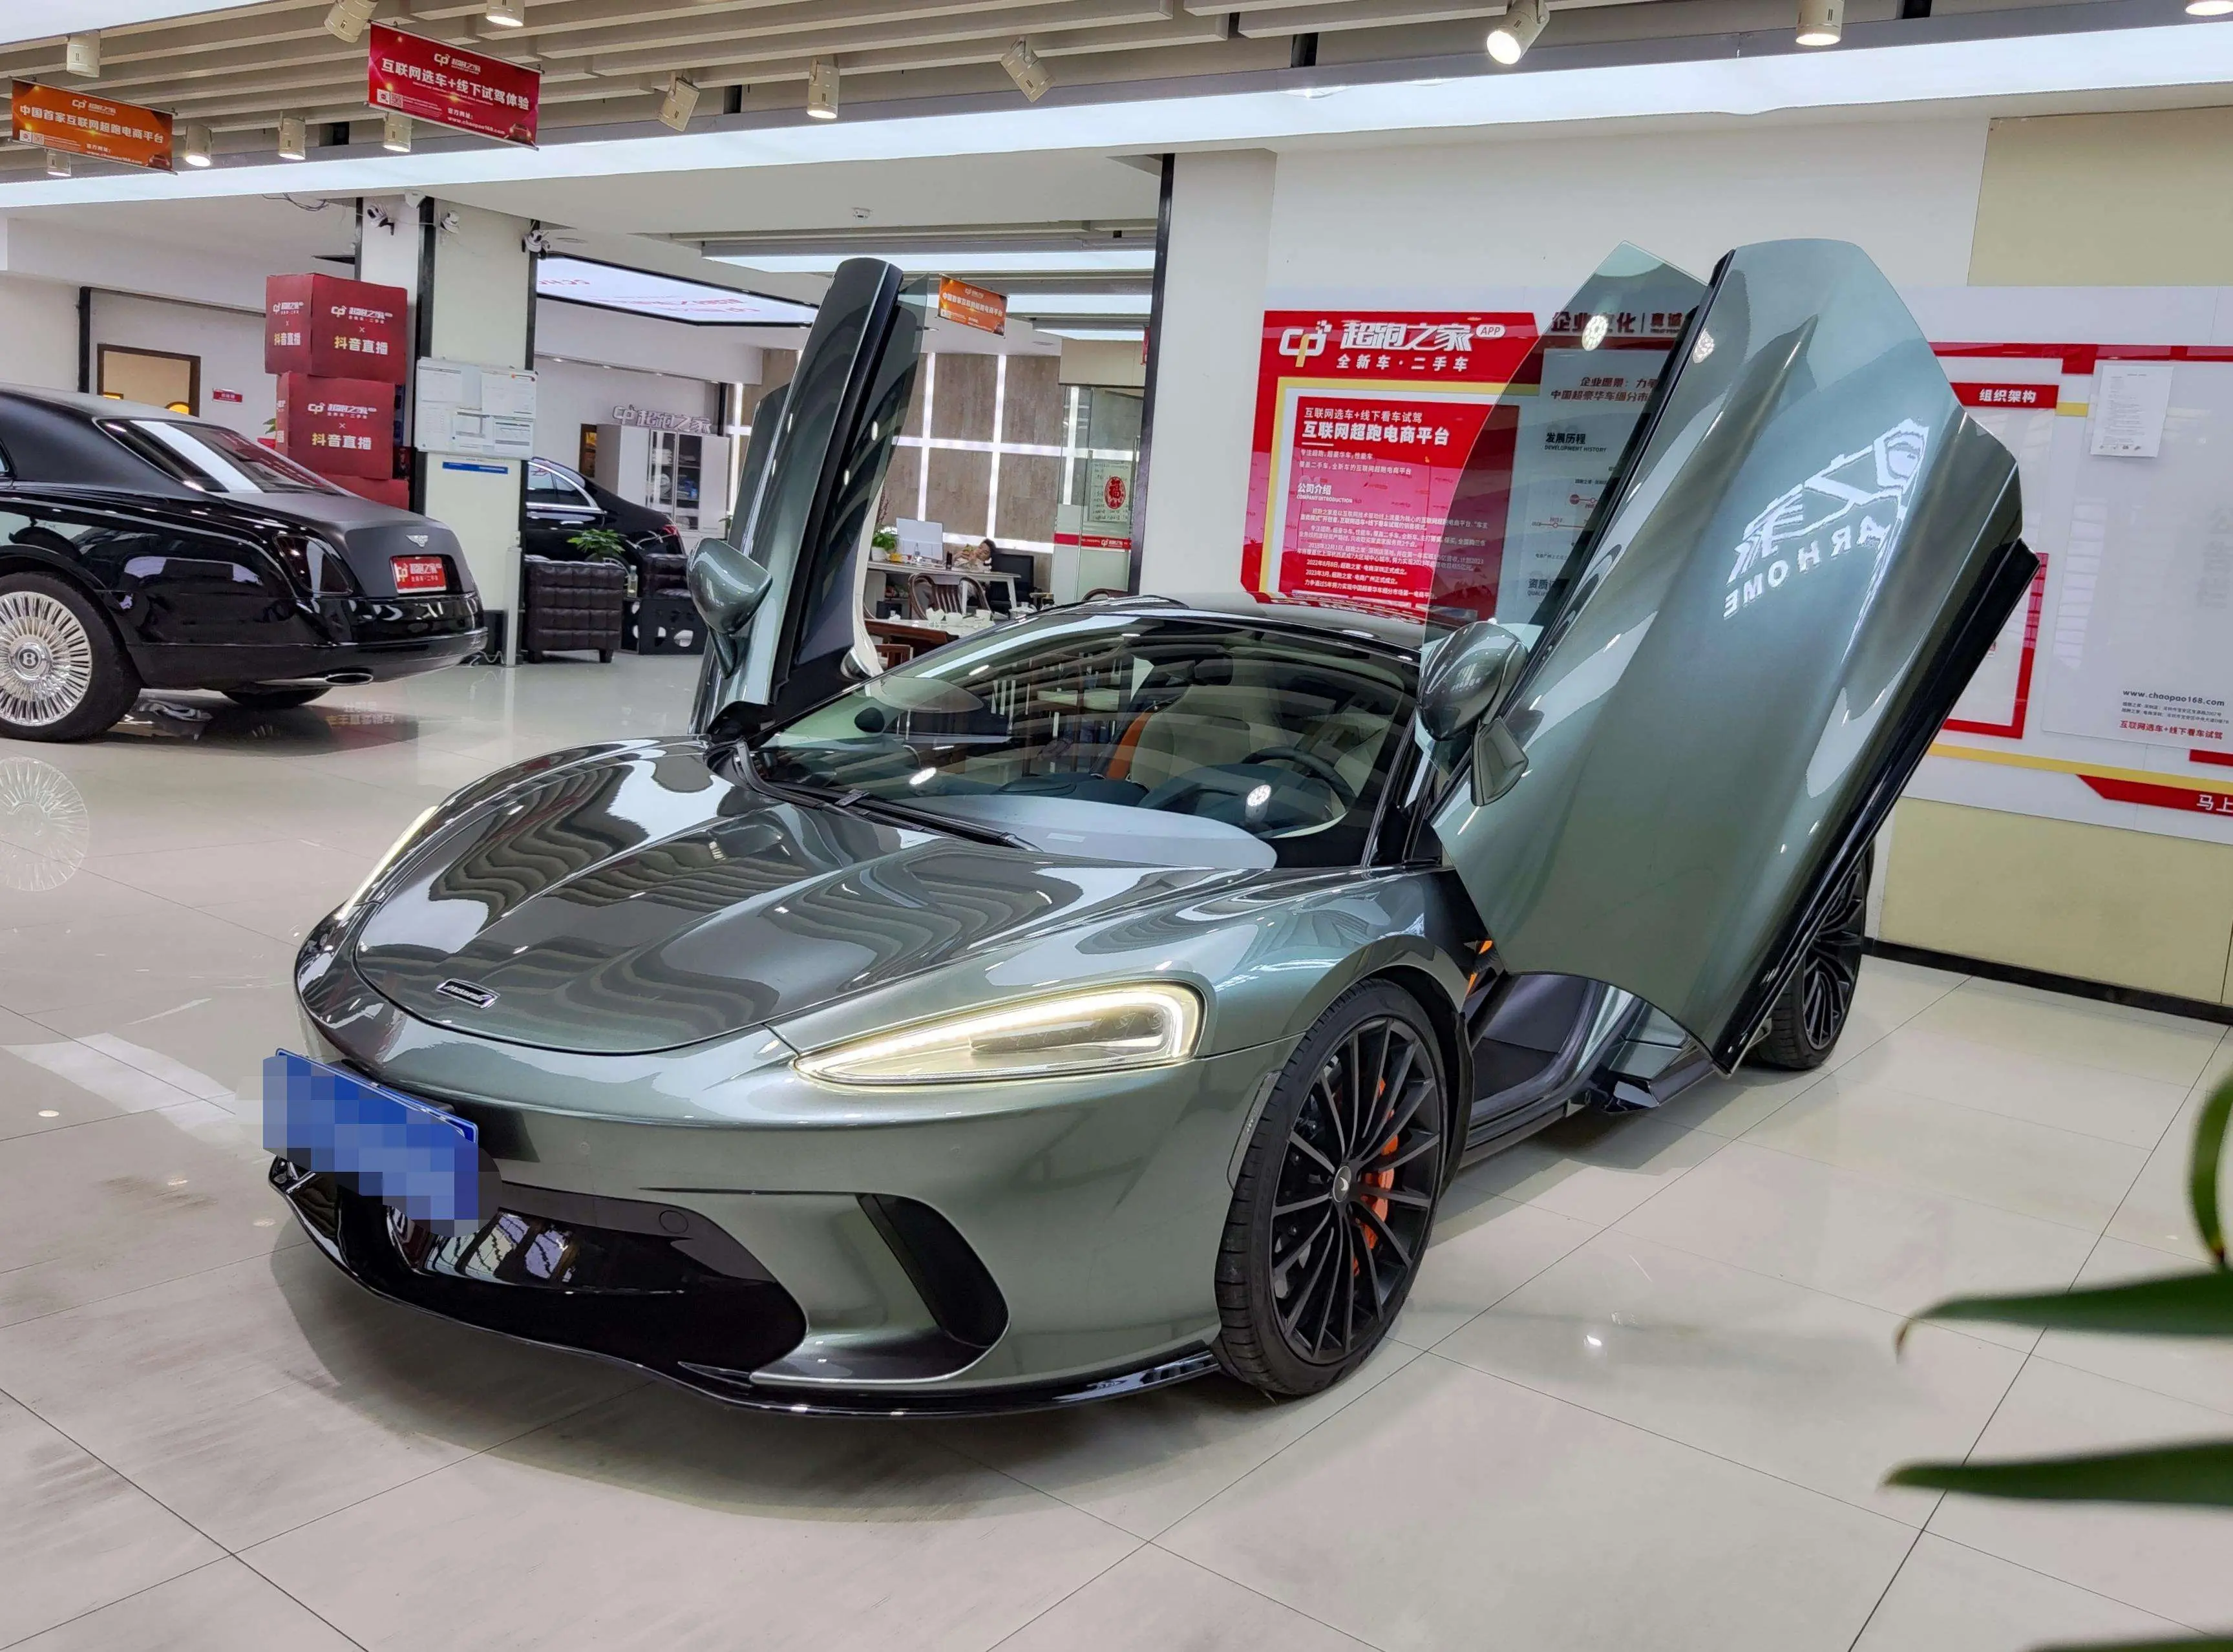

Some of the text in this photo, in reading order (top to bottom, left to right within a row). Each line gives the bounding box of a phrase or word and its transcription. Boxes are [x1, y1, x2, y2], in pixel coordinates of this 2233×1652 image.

[381, 58, 530, 111] 互联网选车+线下试驾体验
[19, 105, 164, 143] 中国首家互联网超跑电商平台
[274, 332, 301, 346] 抖音直播
[1340, 320, 1474, 352] 超跑之家
[1480, 326, 1501, 336] APP
[333, 335, 388, 355] 抖音直播
[1979, 389, 2037, 404] 组织架构
[1304, 407, 1423, 423] 互联网选车+线下看车试驾
[312, 432, 372, 450] 抖音直播
[1302, 421, 1450, 446] 互联网超跑电商平台
[1545, 432, 1586, 445] 发展历程
[1297, 482, 1332, 496] 公司介绍
[2122, 690, 2225, 706] www.chaopao168.com
[2119, 719, 2224, 740] 互联网选车+线下看车试驾
[2196, 794, 2233, 813] 马上
